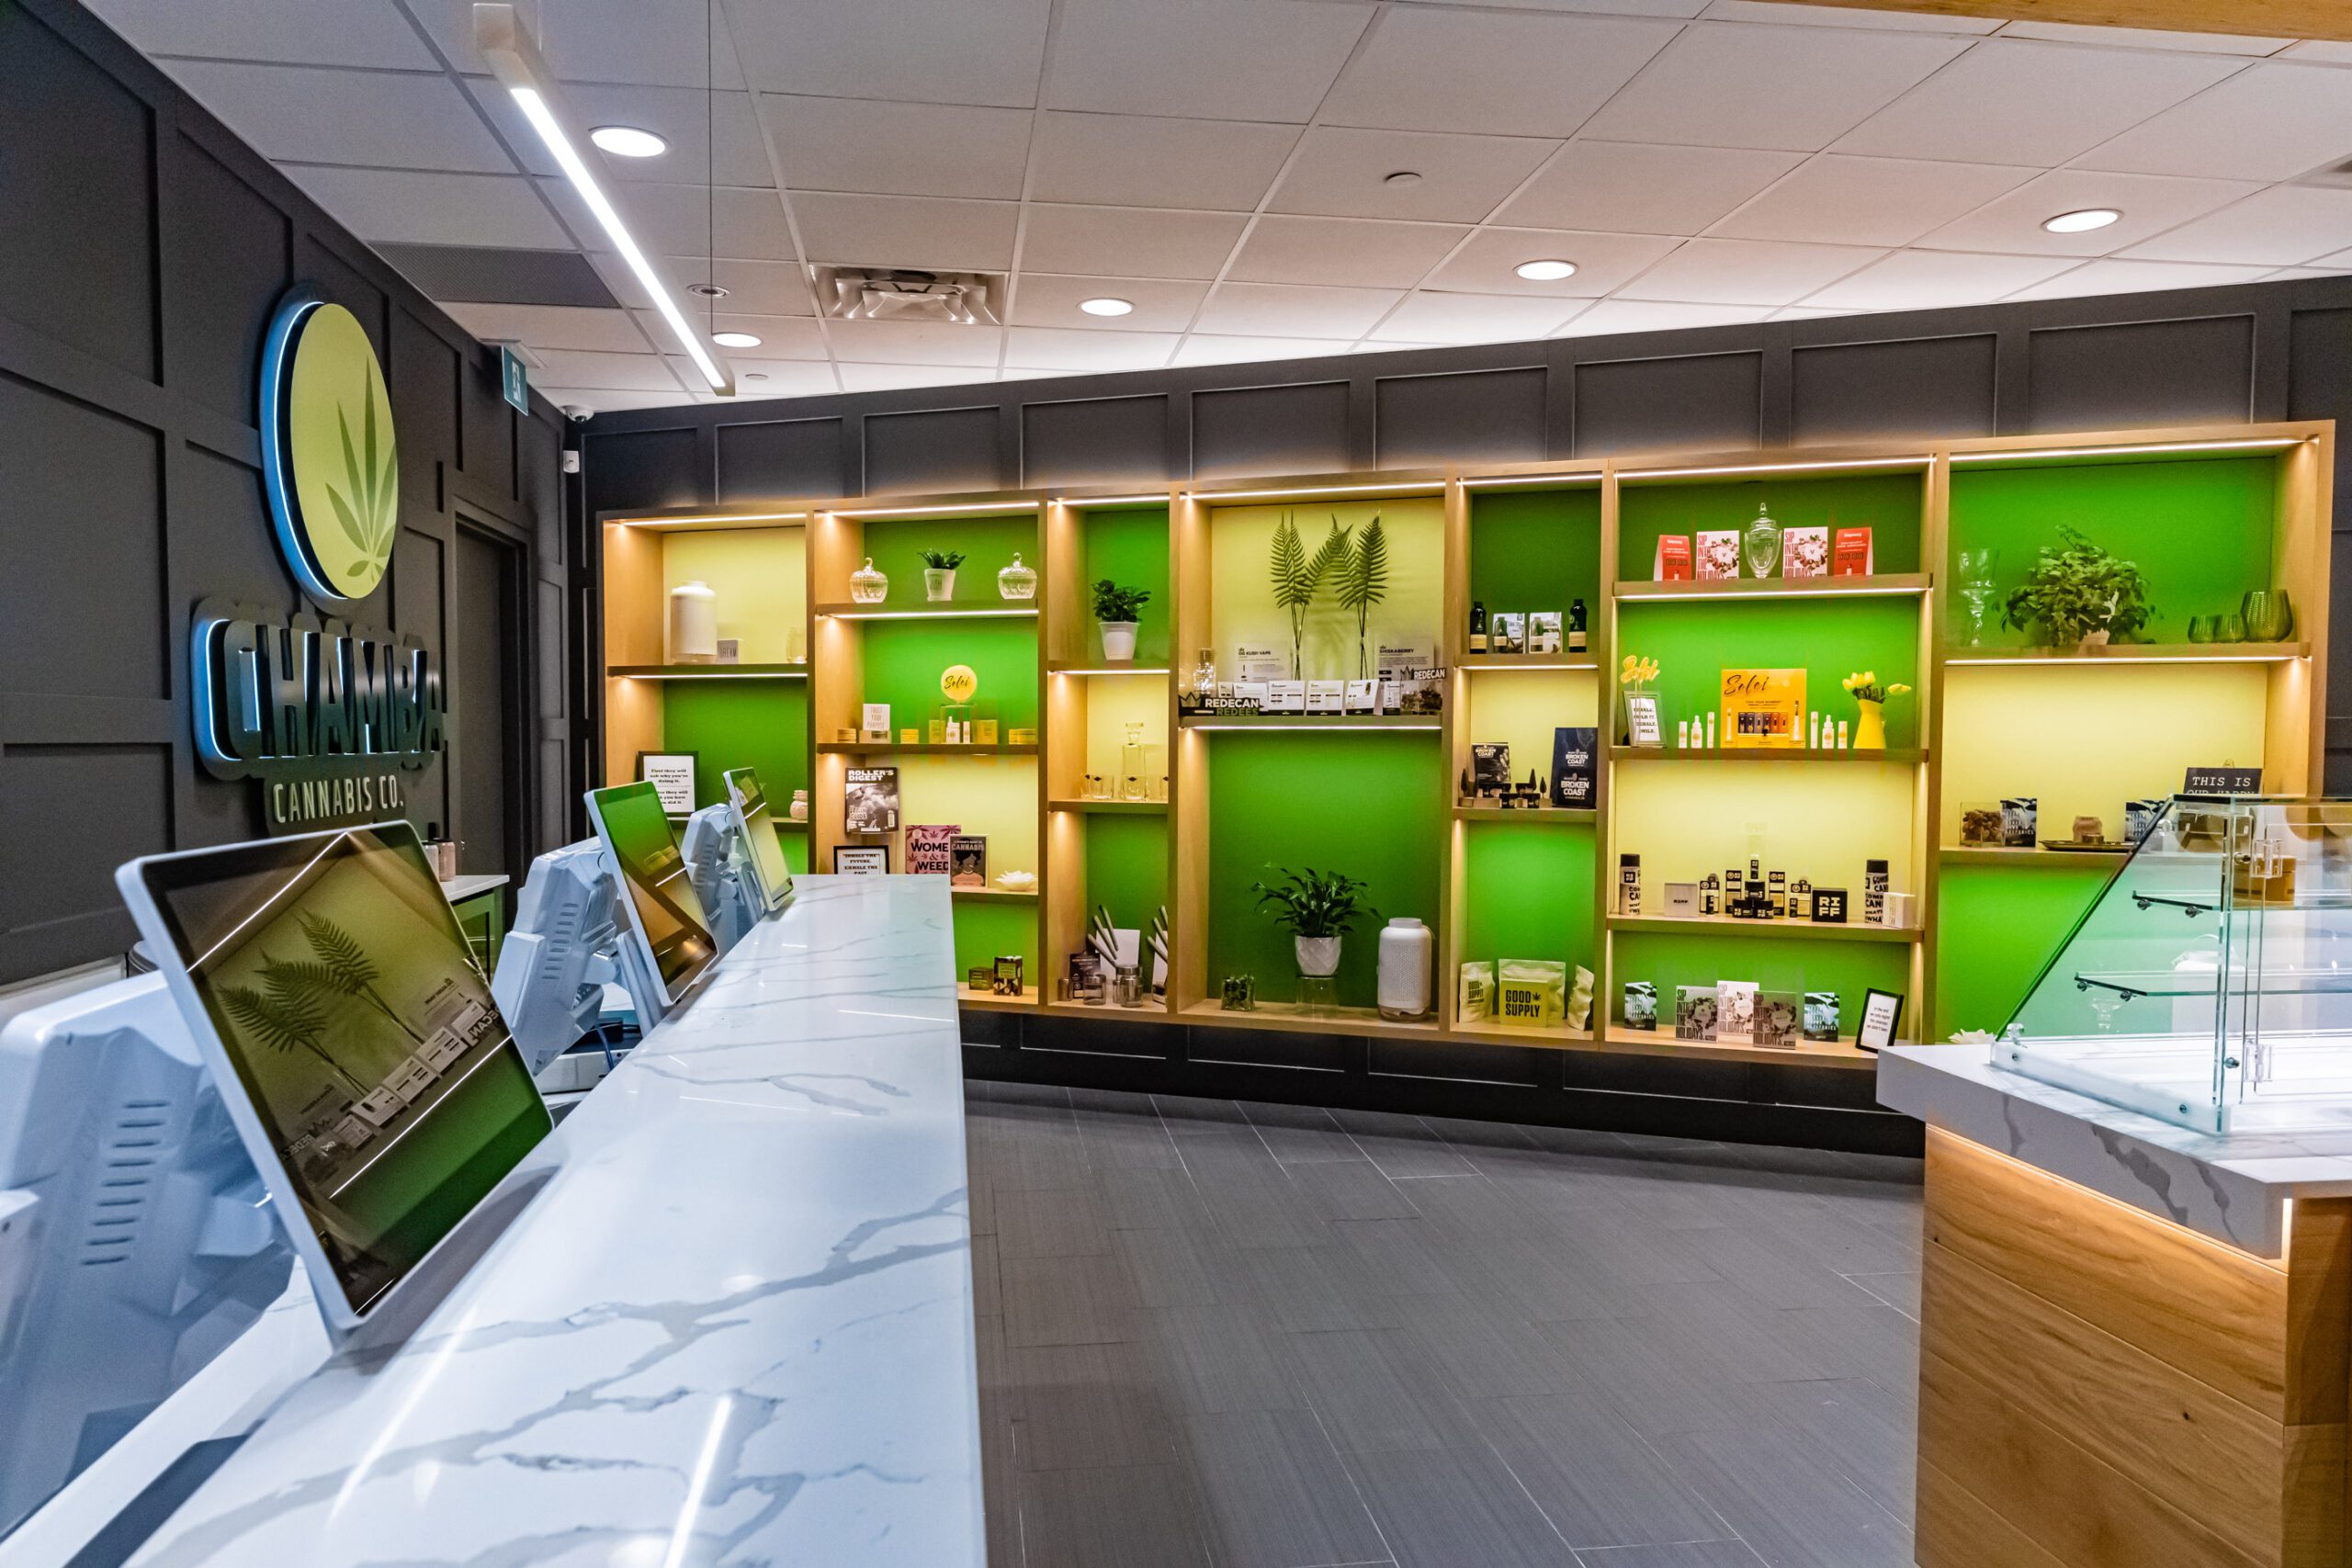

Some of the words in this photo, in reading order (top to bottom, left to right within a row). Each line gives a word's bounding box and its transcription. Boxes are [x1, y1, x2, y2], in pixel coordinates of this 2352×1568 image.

[1697, 535, 1707, 546] SIP
[1785, 532, 1794, 542] SIP
[1414, 669, 1445, 680] REDECAN
[944, 675, 969, 689] Solei
[1724, 674, 1770, 695] Solei
[204, 618, 447, 761] CHAMBA
[1204, 698, 1260, 707] REDECAN
[1216, 707, 1260, 716] REDEES
[2192, 777, 2225, 786] THIS
[2234, 777, 2251, 787] IS
[273, 775, 373, 823] CANNABIS
[379, 774, 404, 809] CO.
[911, 842, 948, 852] WOME
[917, 862, 948, 871] WEED
[1505, 989, 1531, 1003] GOOD
[1677, 989, 1687, 1000] SIP
[1505, 1003, 1540, 1018] SUPPLY
